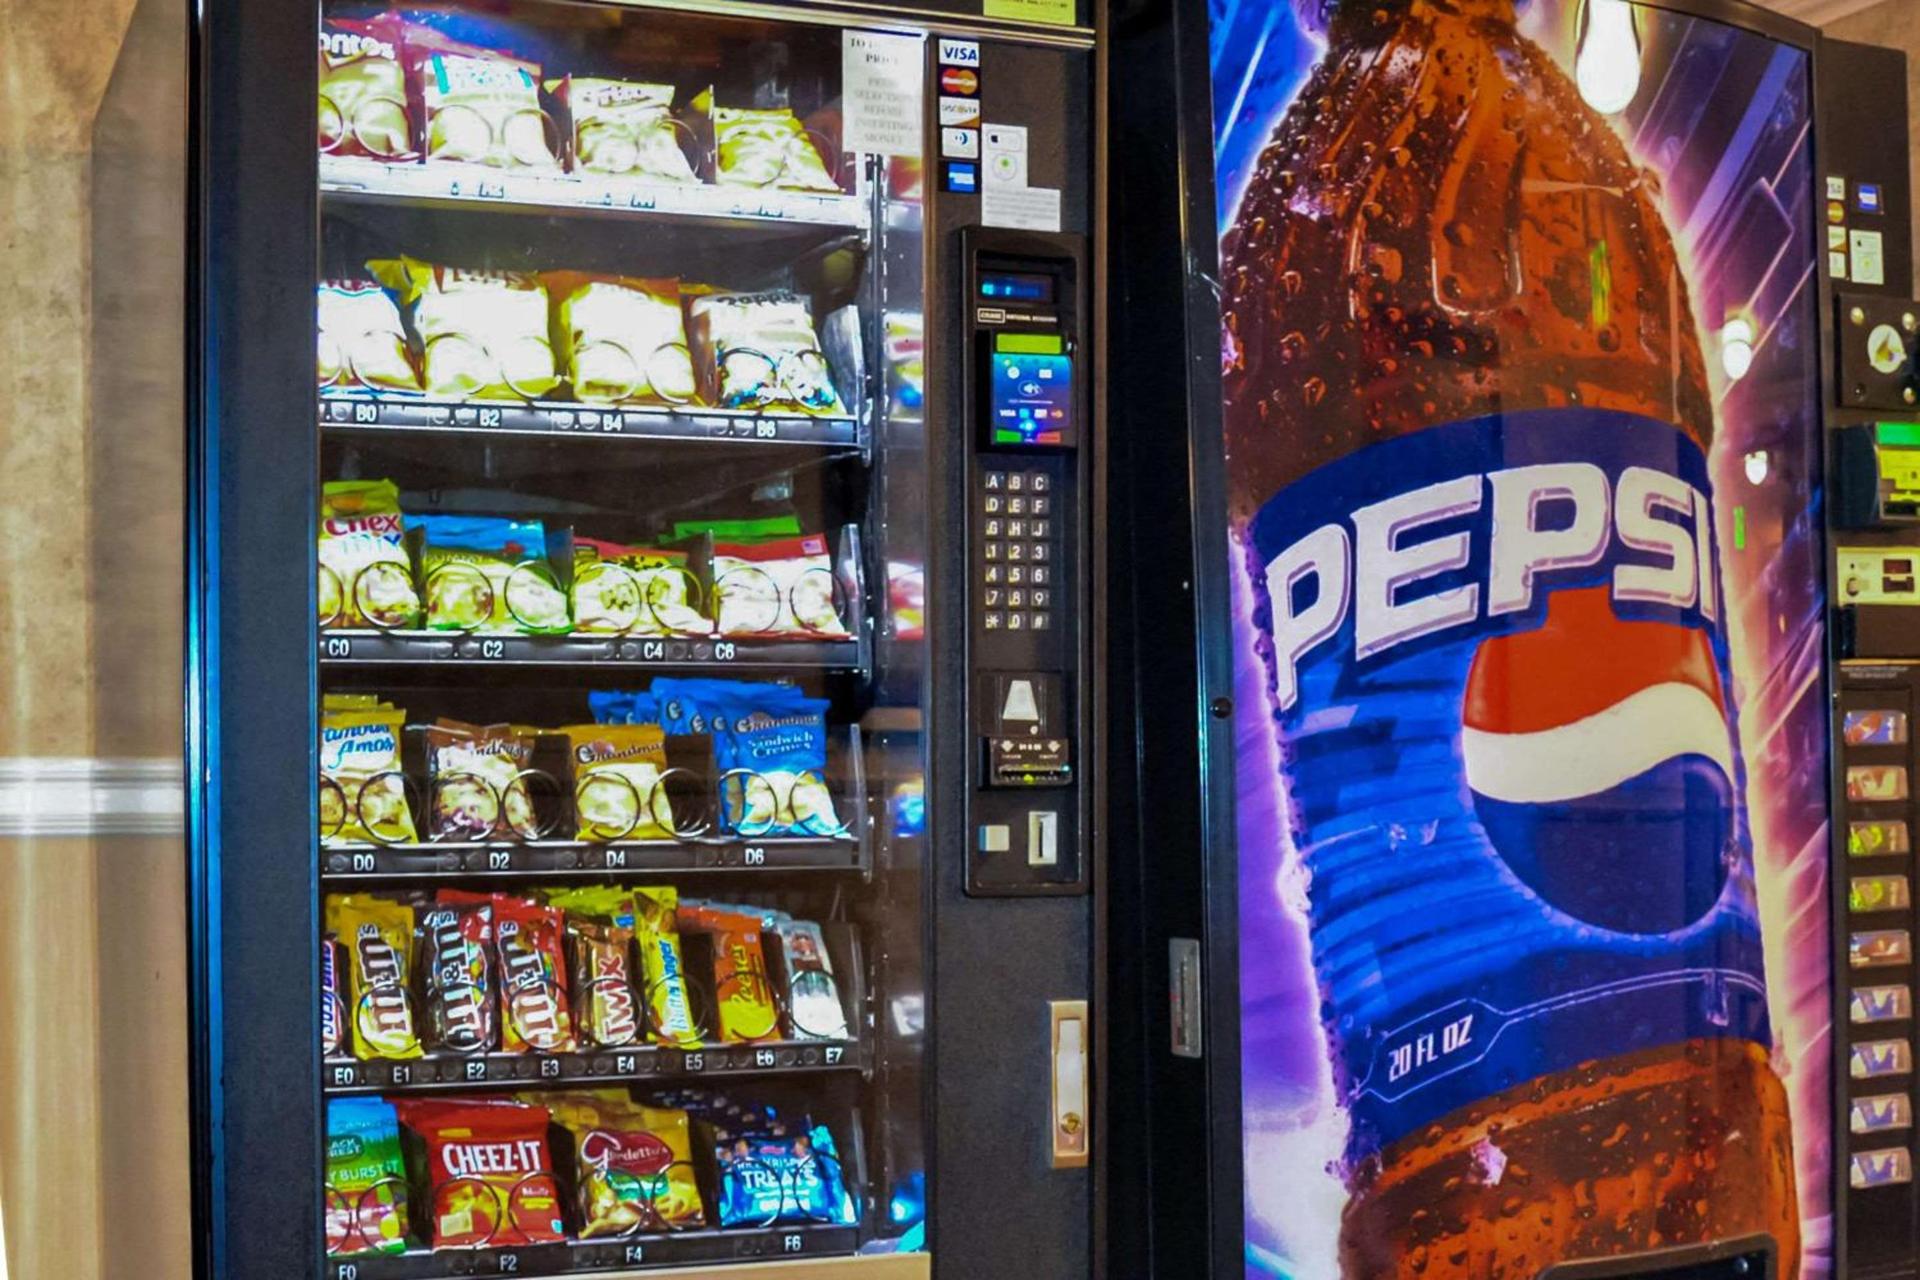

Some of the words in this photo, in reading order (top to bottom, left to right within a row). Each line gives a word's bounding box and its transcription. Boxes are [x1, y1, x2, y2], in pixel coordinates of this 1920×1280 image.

[944, 47, 977, 61] VISA
[480, 408, 499, 427] B2
[603, 411, 622, 431] B4
[989, 475, 998, 488] A
[1012, 476, 1021, 489] B
[1035, 477, 1044, 490] C
[989, 498, 998, 511] D
[1013, 499, 1021, 513] E
[1035, 500, 1043, 513] F
[989, 521, 998, 535] G
[1012, 522, 1021, 535] H
[1034, 522, 1043, 536] J
[990, 544, 996, 558] 1
[1013, 545, 1021, 559] 2
[1035, 546, 1043, 559] 3
[989, 568, 997, 581] 4
[1013, 568, 1021, 581] 5
[1035, 569, 1043, 582] 6
[1265, 461, 1717, 712] PEPSI
[990, 591, 998, 604] 7
[1013, 592, 1021, 605] 8
[1035, 592, 1043, 605] 9
[1013, 615, 1020, 628] 0
[329, 639, 349, 657] C0
[483, 641, 503, 658] C2
[644, 643, 664, 659] C4
[747, 731, 814, 747] Sandwich
[328, 736, 395, 769] Amos
[354, 854, 374, 871] D0
[489, 853, 510, 869] D2
[606, 851, 625, 867] D4
[1388, 1043, 1412, 1083] 20
[1416, 1032, 1439, 1067] FL
[1442, 1013, 1473, 1054] OZ
[686, 1055, 703, 1069] E5
[826, 1048, 843, 1063] E7
[467, 1063, 485, 1079] E2
[542, 1060, 559, 1076] E3
[617, 1057, 634, 1072] E4
[335, 1068, 353, 1083] E0
[393, 1067, 410, 1082] E1
[331, 1138, 355, 1149] ACK
[329, 1145, 361, 1157] REST
[339, 1164, 384, 1181] BURST
[741, 1169, 819, 1189] TREATS
[785, 1236, 801, 1251] F6
[626, 1246, 643, 1262] F4
[500, 1255, 517, 1271] F2
